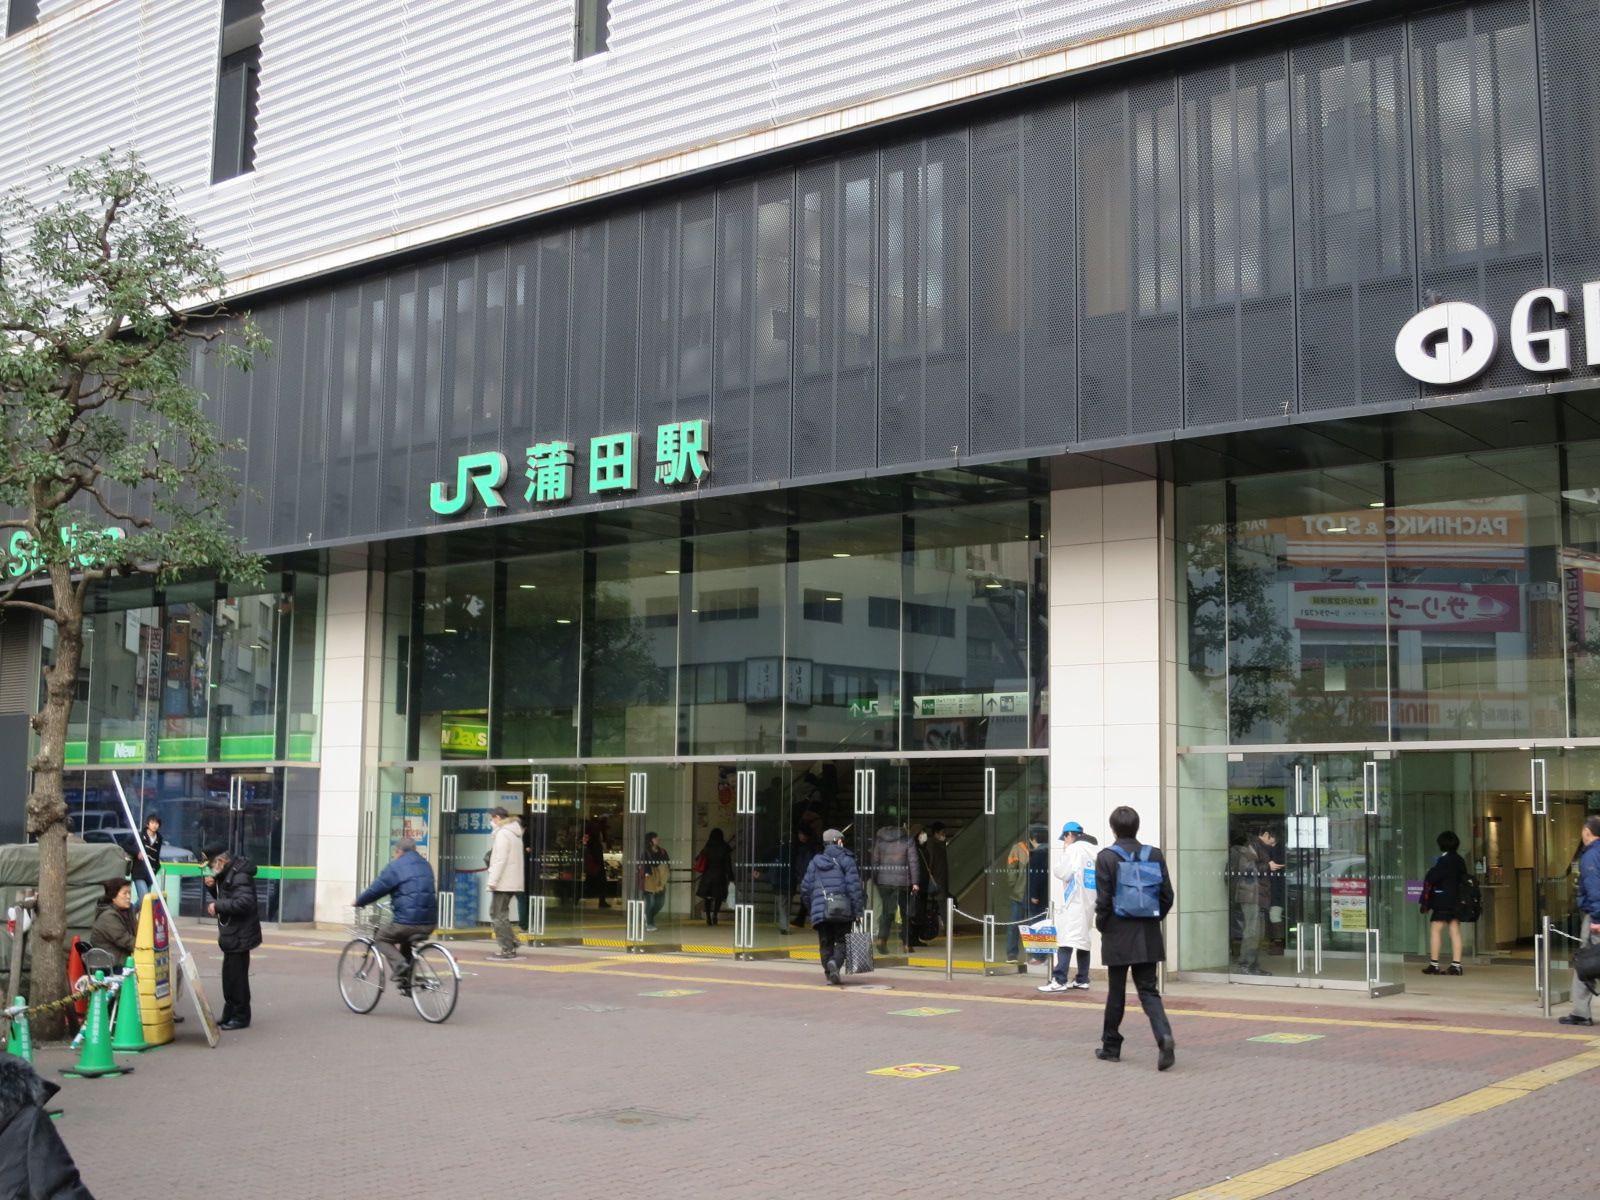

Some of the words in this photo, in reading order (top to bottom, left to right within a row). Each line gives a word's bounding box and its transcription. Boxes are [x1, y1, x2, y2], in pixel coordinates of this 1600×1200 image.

[1510, 280, 1600, 373] G
[430, 451, 508, 515] JR
[524, 419, 710, 504] 蒲田駅
